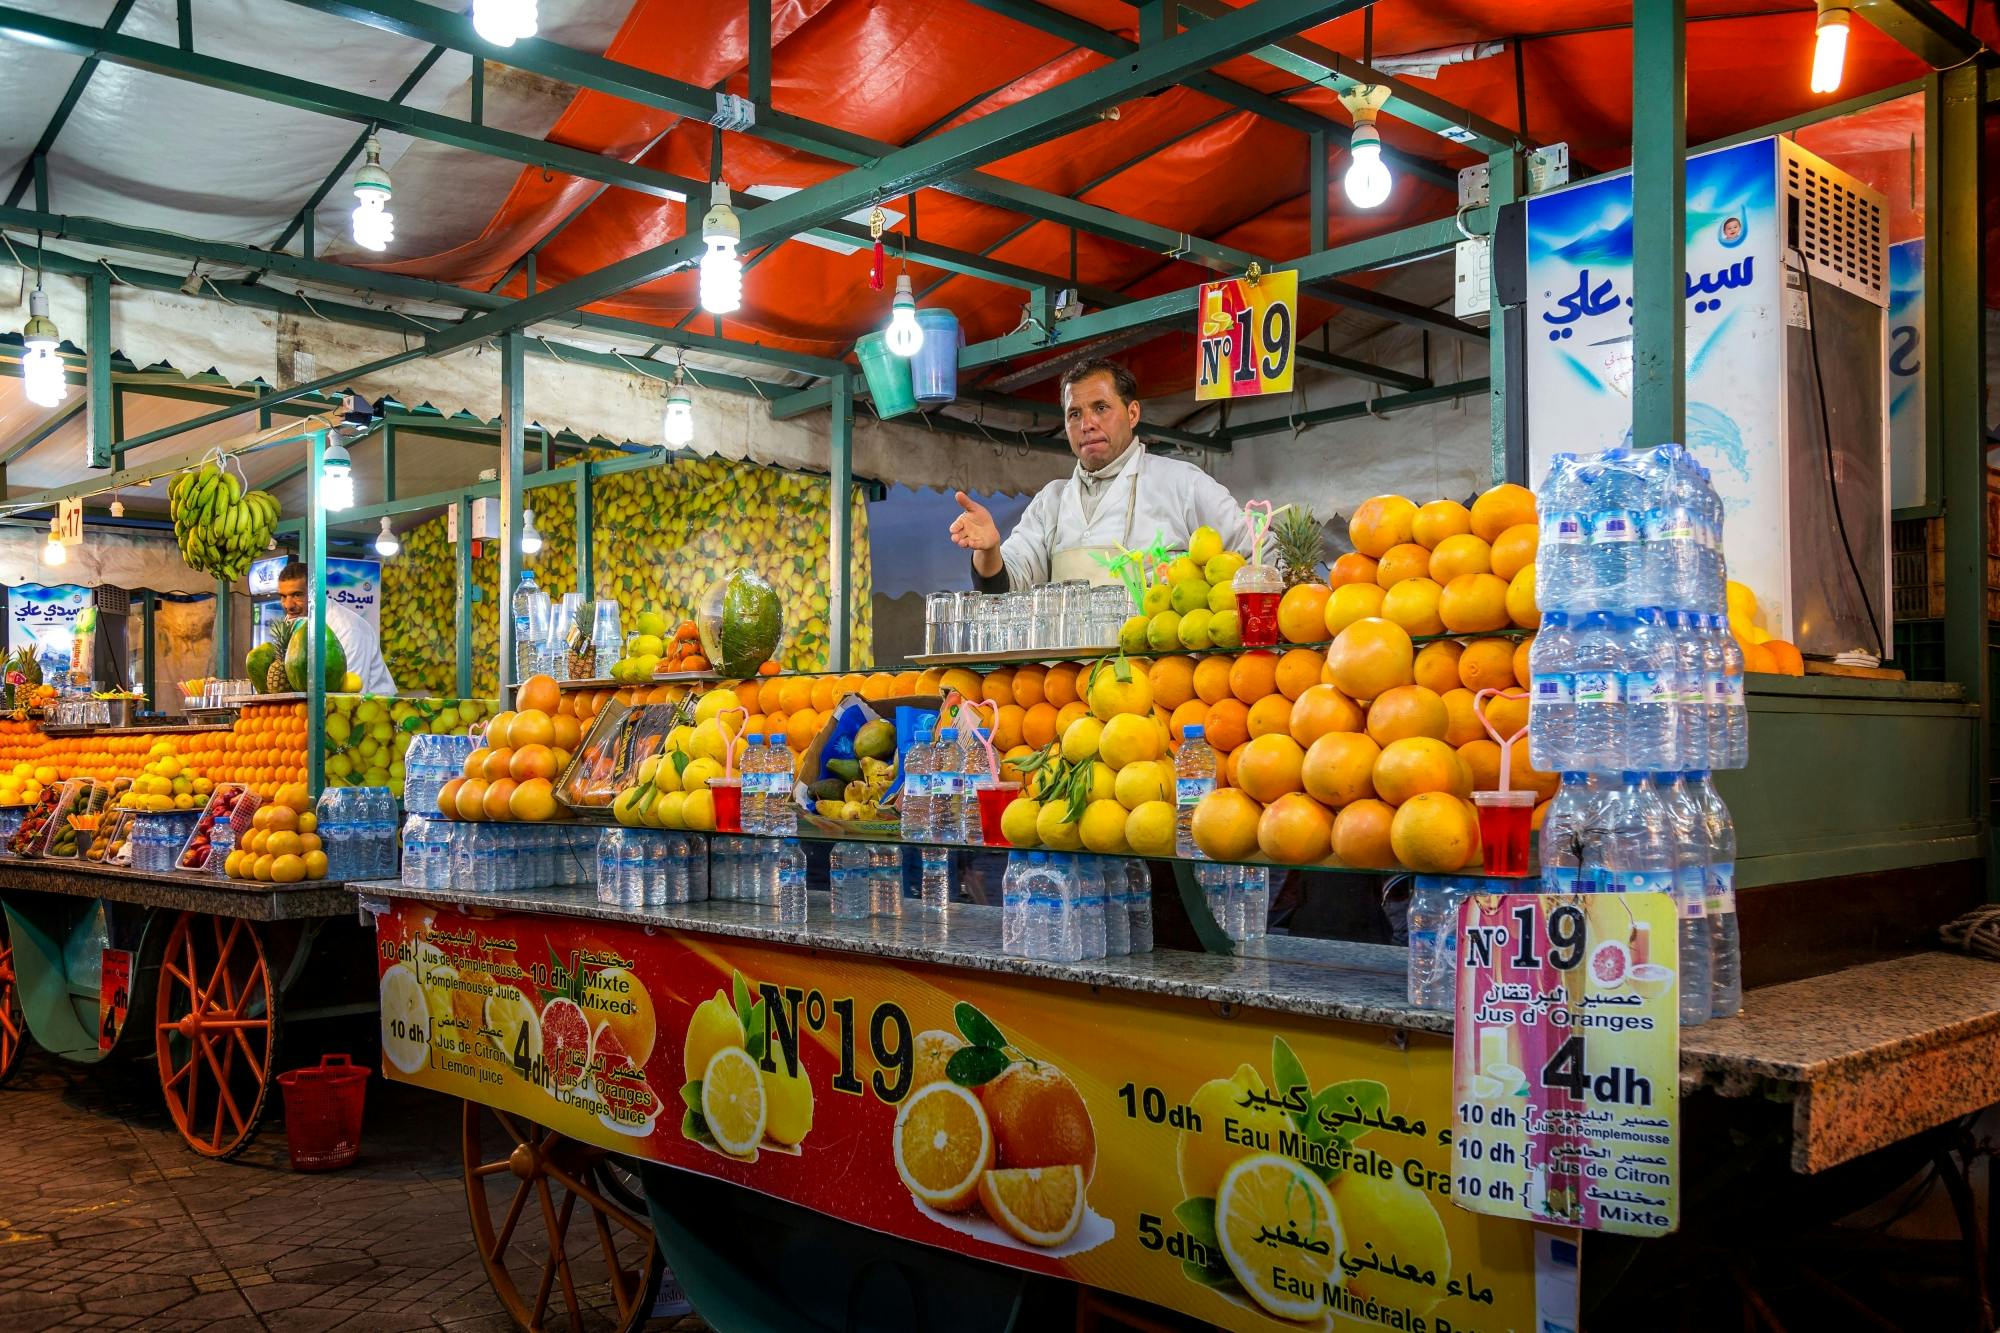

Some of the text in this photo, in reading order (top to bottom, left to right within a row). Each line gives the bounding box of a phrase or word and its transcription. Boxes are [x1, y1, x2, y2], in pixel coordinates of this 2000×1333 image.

[1542, 269, 1621, 341] علي
[381, 941, 411, 961] 10 dh
[479, 937, 518, 950] عصير
[423, 951, 523, 980] Jus de Pomplemousse
[580, 949, 634, 969] مختلط
[426, 971, 520, 1002] Pomplemousse Juice
[530, 963, 566, 989] 10 dh
[583, 970, 629, 993] Mixte
[581, 991, 631, 1015] Mixed
[1485, 984, 1643, 1012] عصير البرتقال
[390, 1019, 424, 1043] 10 dh
[476, 1026, 504, 1038] عصير
[1475, 1006, 1515, 1023] Jus
[1550, 1009, 1655, 1032] Oranges
[437, 1034, 506, 1063] Jus de Citron
[441, 1055, 504, 1086] Lemon juice
[609, 1065, 646, 1081] عصير
[560, 1070, 578, 1088] Jus
[595, 1078, 651, 1106] Oranges
[1234, 1084, 1309, 1117] كبير
[563, 1090, 646, 1125] Oranges juice
[1317, 1095, 1427, 1137] معدني
[1459, 1103, 1516, 1127] 10 dh
[1534, 1121, 1671, 1145] Jus de Pomplemousse
[1620, 1114, 1670, 1128] عصير
[1224, 1116, 1271, 1151] Eau
[1279, 1129, 1394, 1180] Minérale
[1458, 1139, 1516, 1164] 10 dh
[1551, 1143, 1669, 1166] عصير الحامض
[1550, 1160, 1671, 1186] Jus de Citron
[1457, 1175, 1515, 1201] 10 dh
[1586, 1185, 1667, 1207] مختلط
[1600, 1204, 1671, 1228] Mixte
[1252, 1219, 1494, 1305] ماء معدني صغير
[1272, 1265, 1426, 1333] Eau Minérale
